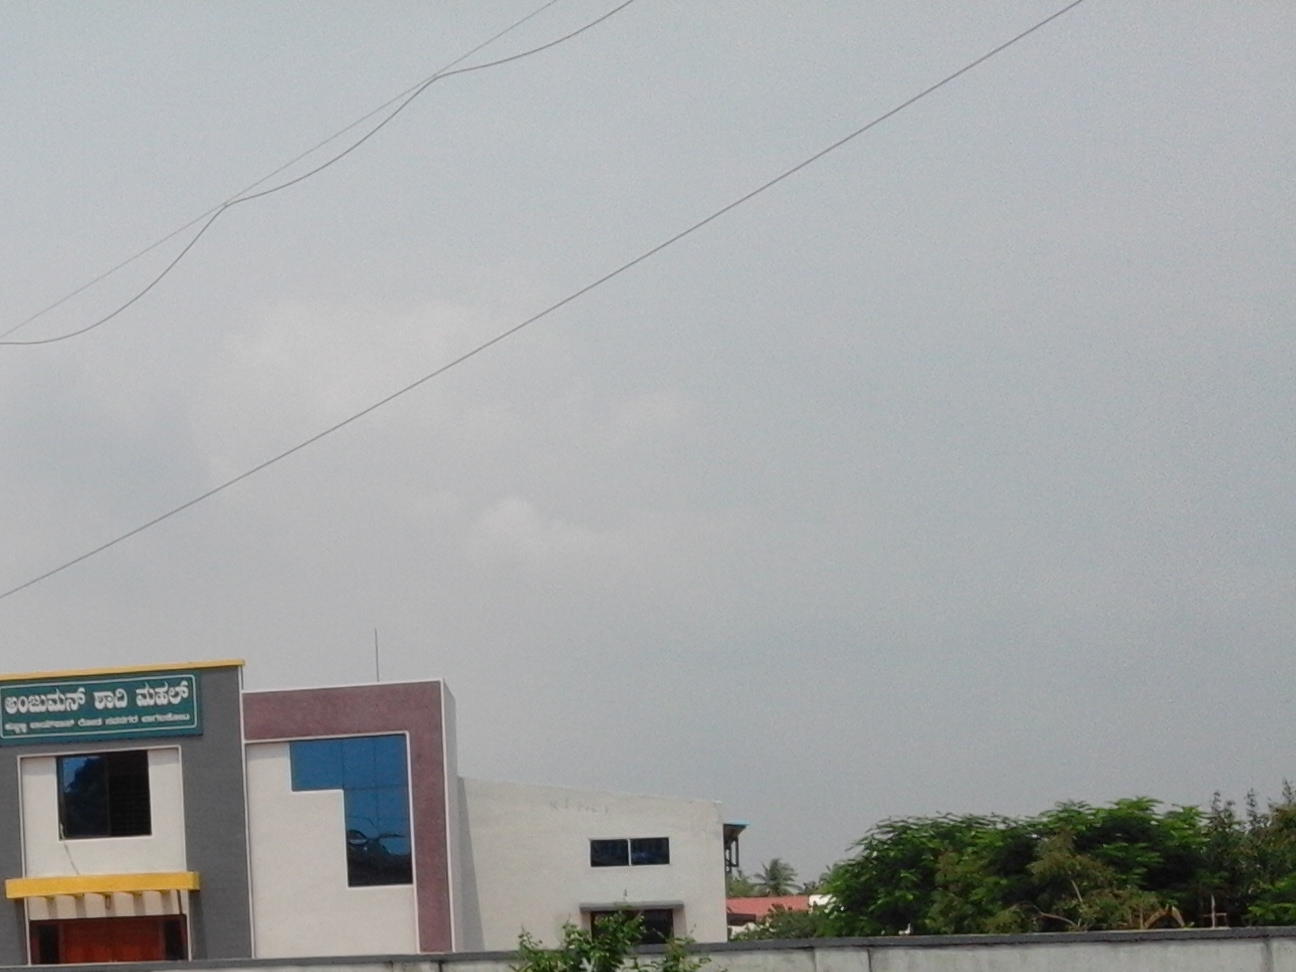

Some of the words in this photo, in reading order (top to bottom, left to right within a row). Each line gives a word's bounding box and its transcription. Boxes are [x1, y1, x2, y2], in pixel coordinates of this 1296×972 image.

[5, 687, 86, 714] ಅಂಜುಮನ್
[93, 688, 128, 710] ಶಾದಿ
[136, 680, 189, 707] ಮಹಲ್
